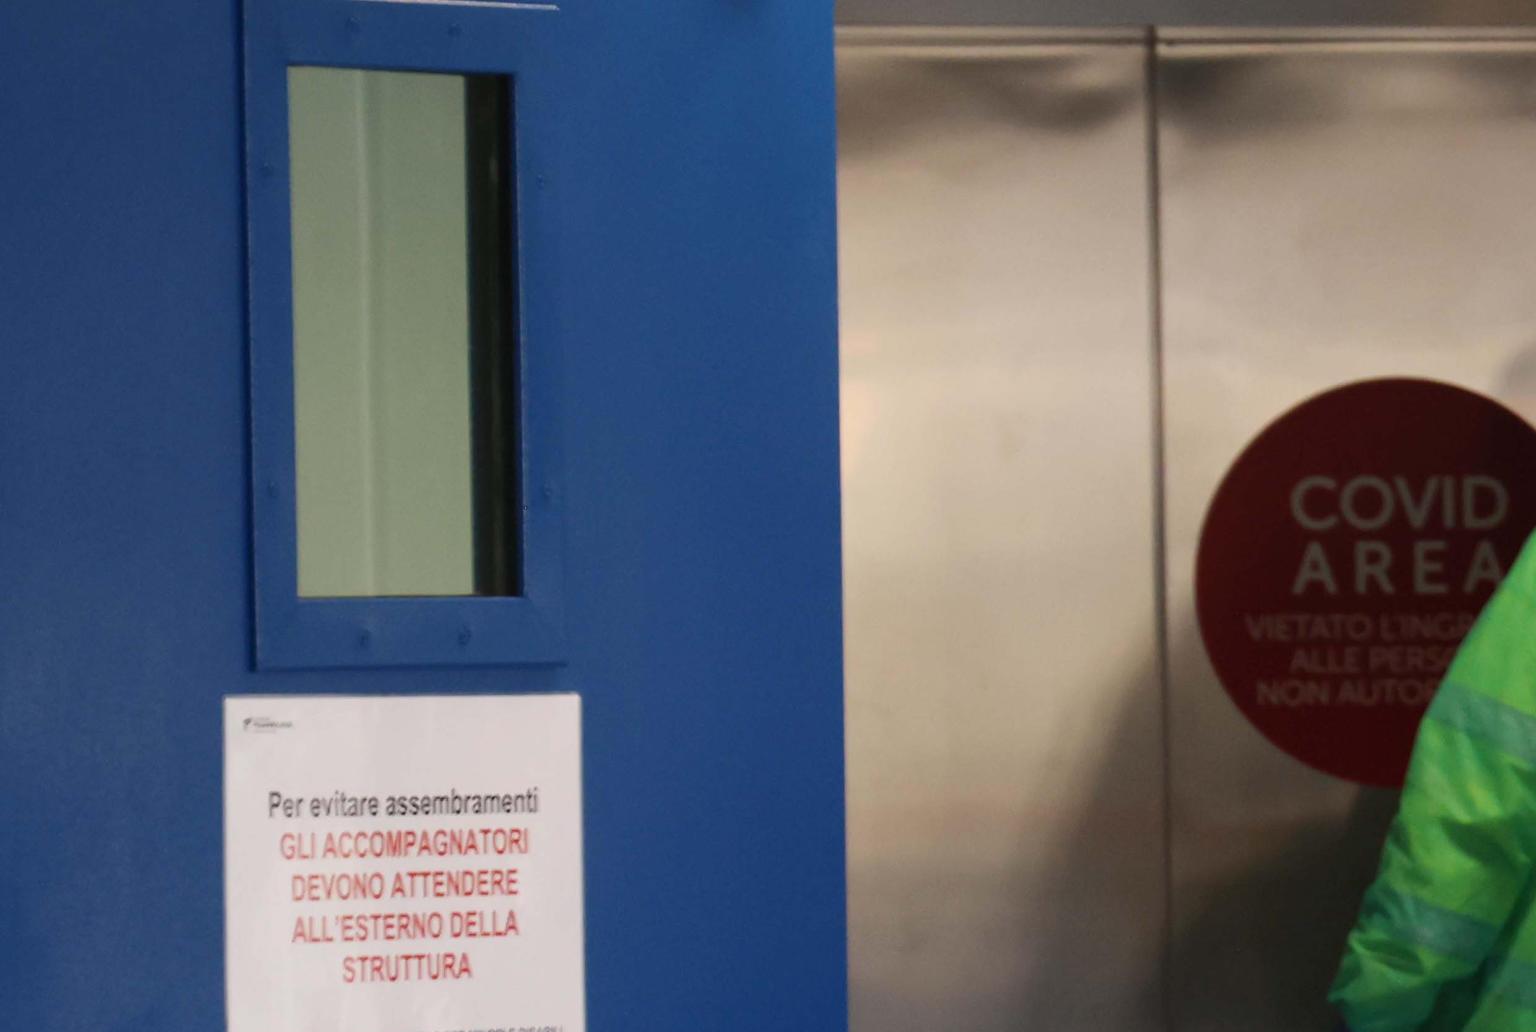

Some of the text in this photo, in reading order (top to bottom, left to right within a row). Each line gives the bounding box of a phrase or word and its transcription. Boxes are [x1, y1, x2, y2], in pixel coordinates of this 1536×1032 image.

[1289, 474, 1510, 531] COVID
[1291, 540, 1504, 596] AREA
[1244, 613, 1370, 642] VIETATO
[1290, 645, 1363, 673] ALLE
[1256, 678, 1330, 706] NON
[268, 787, 540, 819] Per evitare assembramenti
[280, 828, 530, 861] GLI ACCOMPAGNATORI
[292, 869, 519, 902] DEVONO ATTENDERE
[292, 910, 520, 943] ALL'ESTERNO DELLA
[342, 952, 473, 983] STRUTTURA
